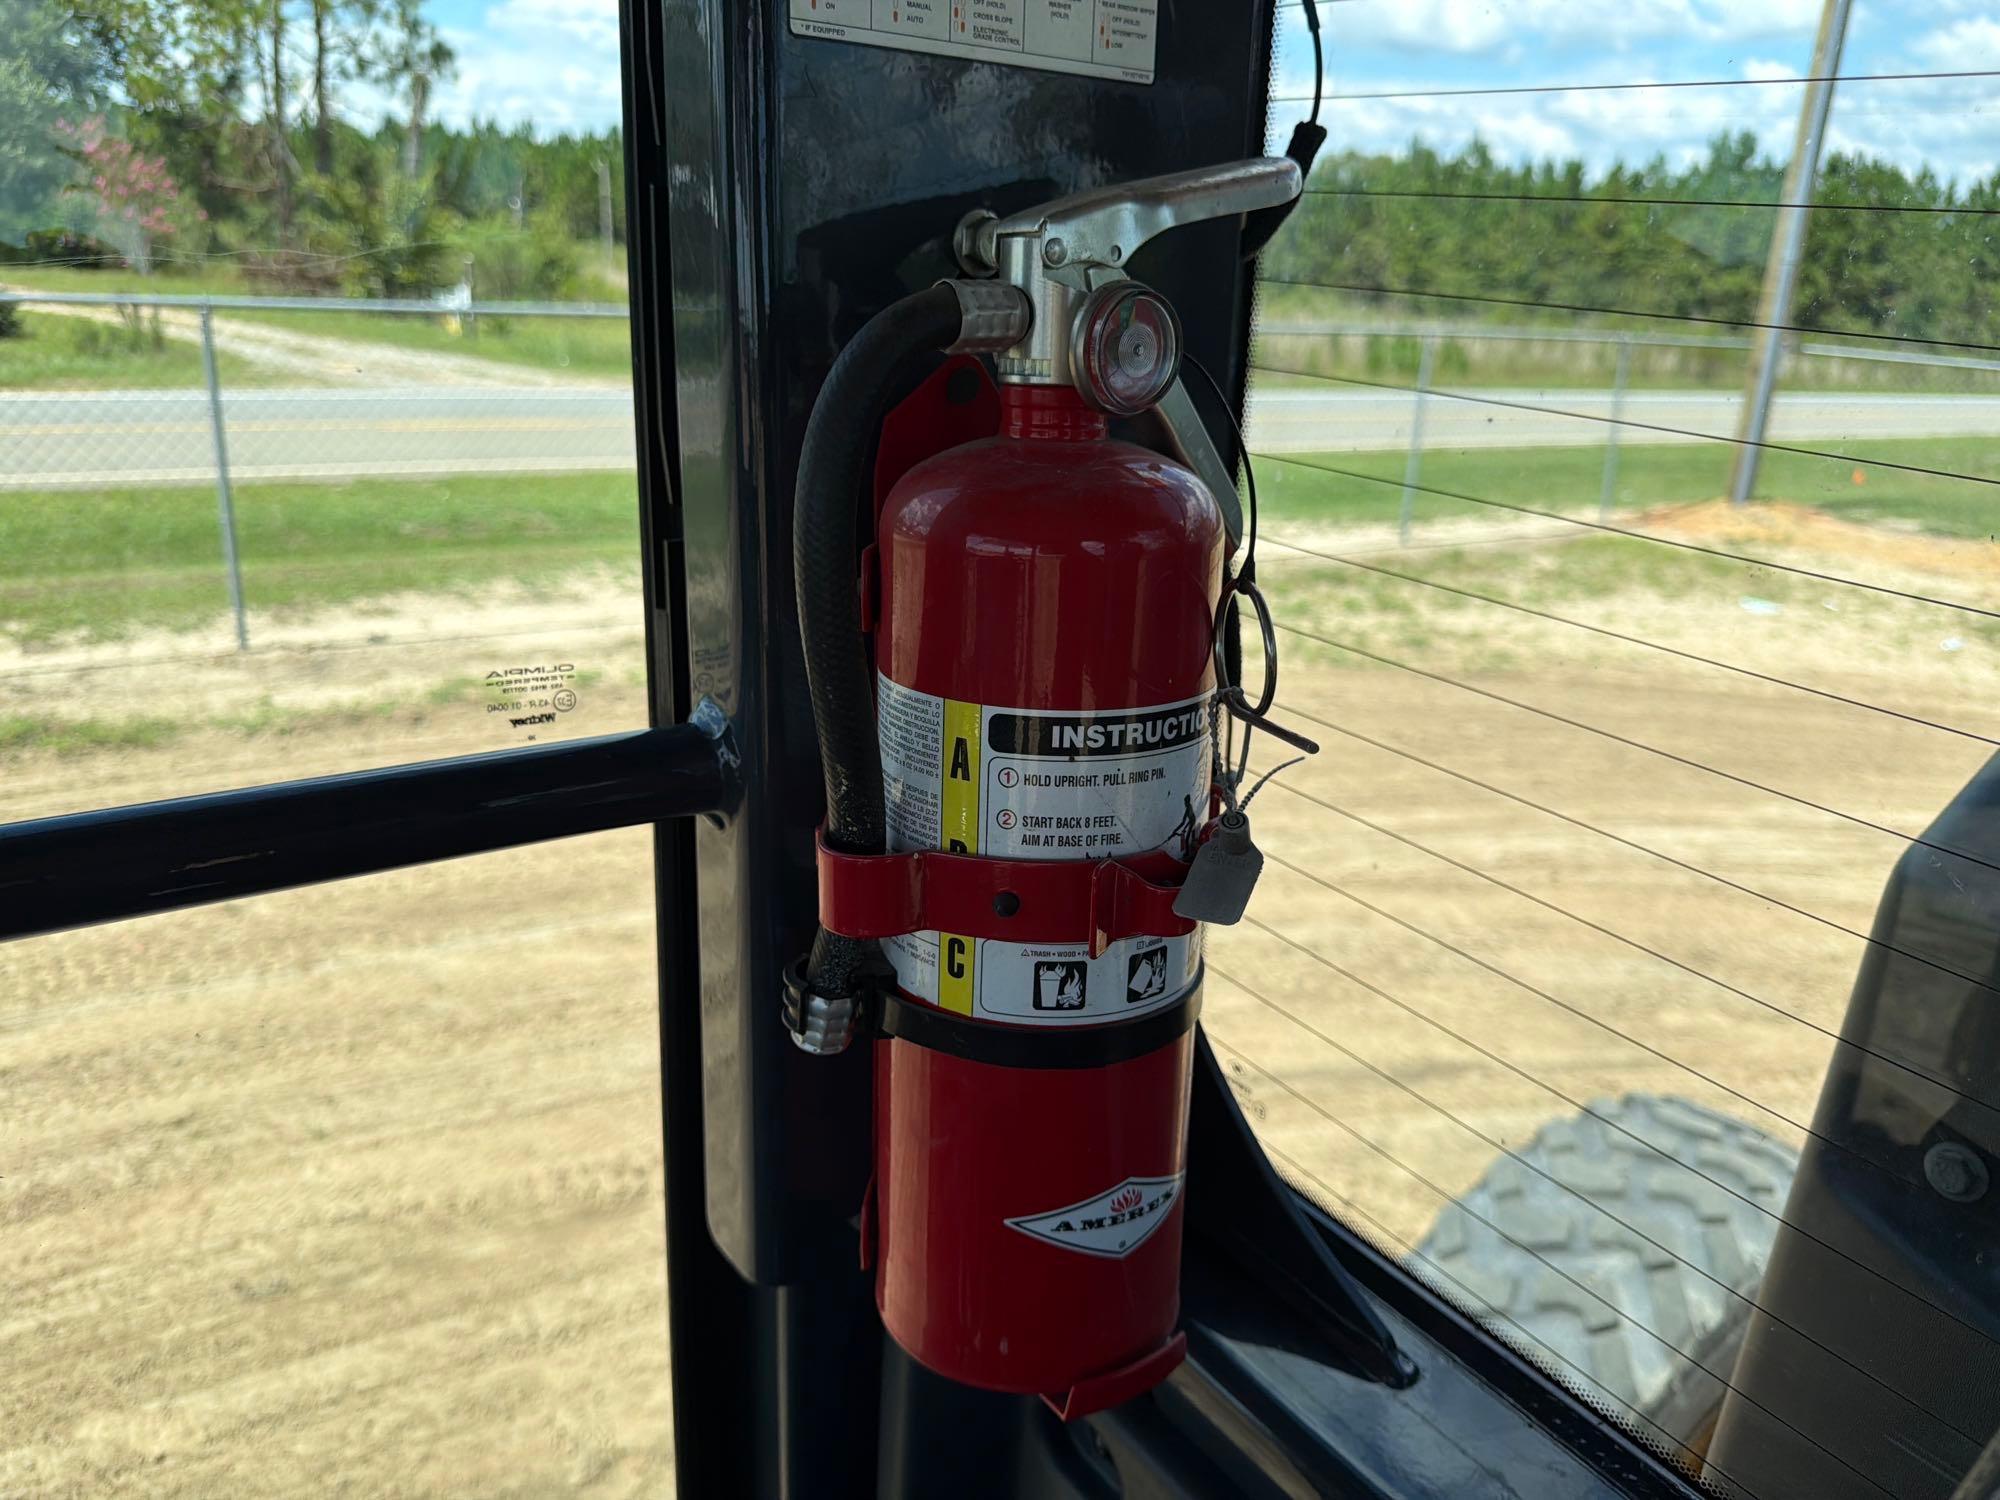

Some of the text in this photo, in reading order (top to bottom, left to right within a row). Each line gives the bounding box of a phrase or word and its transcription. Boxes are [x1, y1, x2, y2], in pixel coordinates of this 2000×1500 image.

[825, 2, 836, 10] ON
[906, 1, 932, 11] MANUAL
[906, 15, 924, 24] AUTO
[973, 12, 1013, 24] CROSS SLOPE
[804, 24, 846, 37] IF EQUIPPED
[973, 25, 1008, 37] ELECTRONIC
[973, 33, 1021, 46] GRADE CONTROL
[932, 710, 941, 719] LO
[1052, 707, 1204, 749] INSTRUCTIO
[914, 731, 929, 742] DEBE
[931, 736, 940, 745] DE
[950, 737, 970, 782] A
[1024, 773, 1051, 787] HOLD
[1054, 773, 1100, 788] UPRIGHT.
[1103, 773, 1126, 786] PULL
[1128, 770, 1149, 785] RING
[1151, 767, 1166, 781] PIN.
[930, 792, 939, 801] DE
[1001, 812, 1117, 829] 2 START BACK 8 FEET.
[1021, 832, 1124, 847] AIM AT BASE OF FIRE.
[947, 937, 965, 979] C
[1057, 950, 1076, 958] WOOD
[1051, 1185, 1174, 1232] AMEREX
